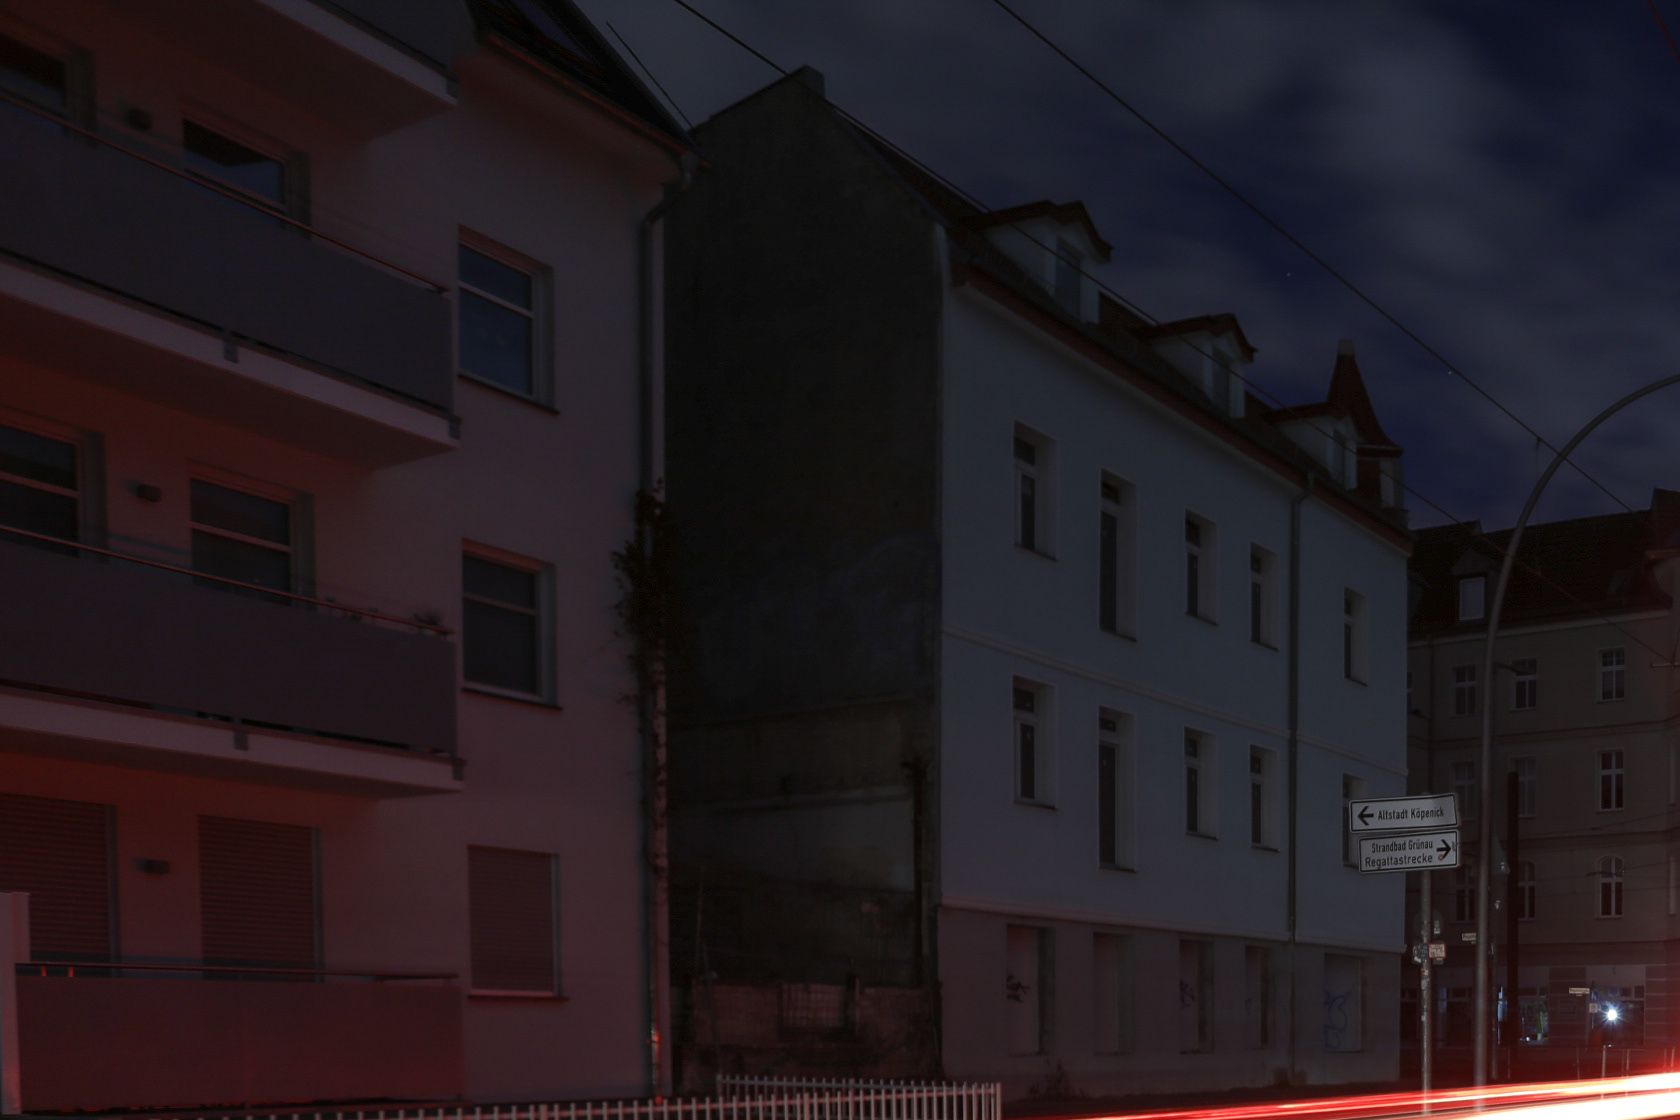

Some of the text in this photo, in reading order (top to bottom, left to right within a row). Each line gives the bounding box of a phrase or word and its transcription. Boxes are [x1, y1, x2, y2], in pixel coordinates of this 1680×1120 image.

[1377, 807, 1444, 821] Altstadt Köpenick
[1371, 839, 1433, 854] Strandbad Grünau
[1365, 853, 1433, 869] Regattastrecke
